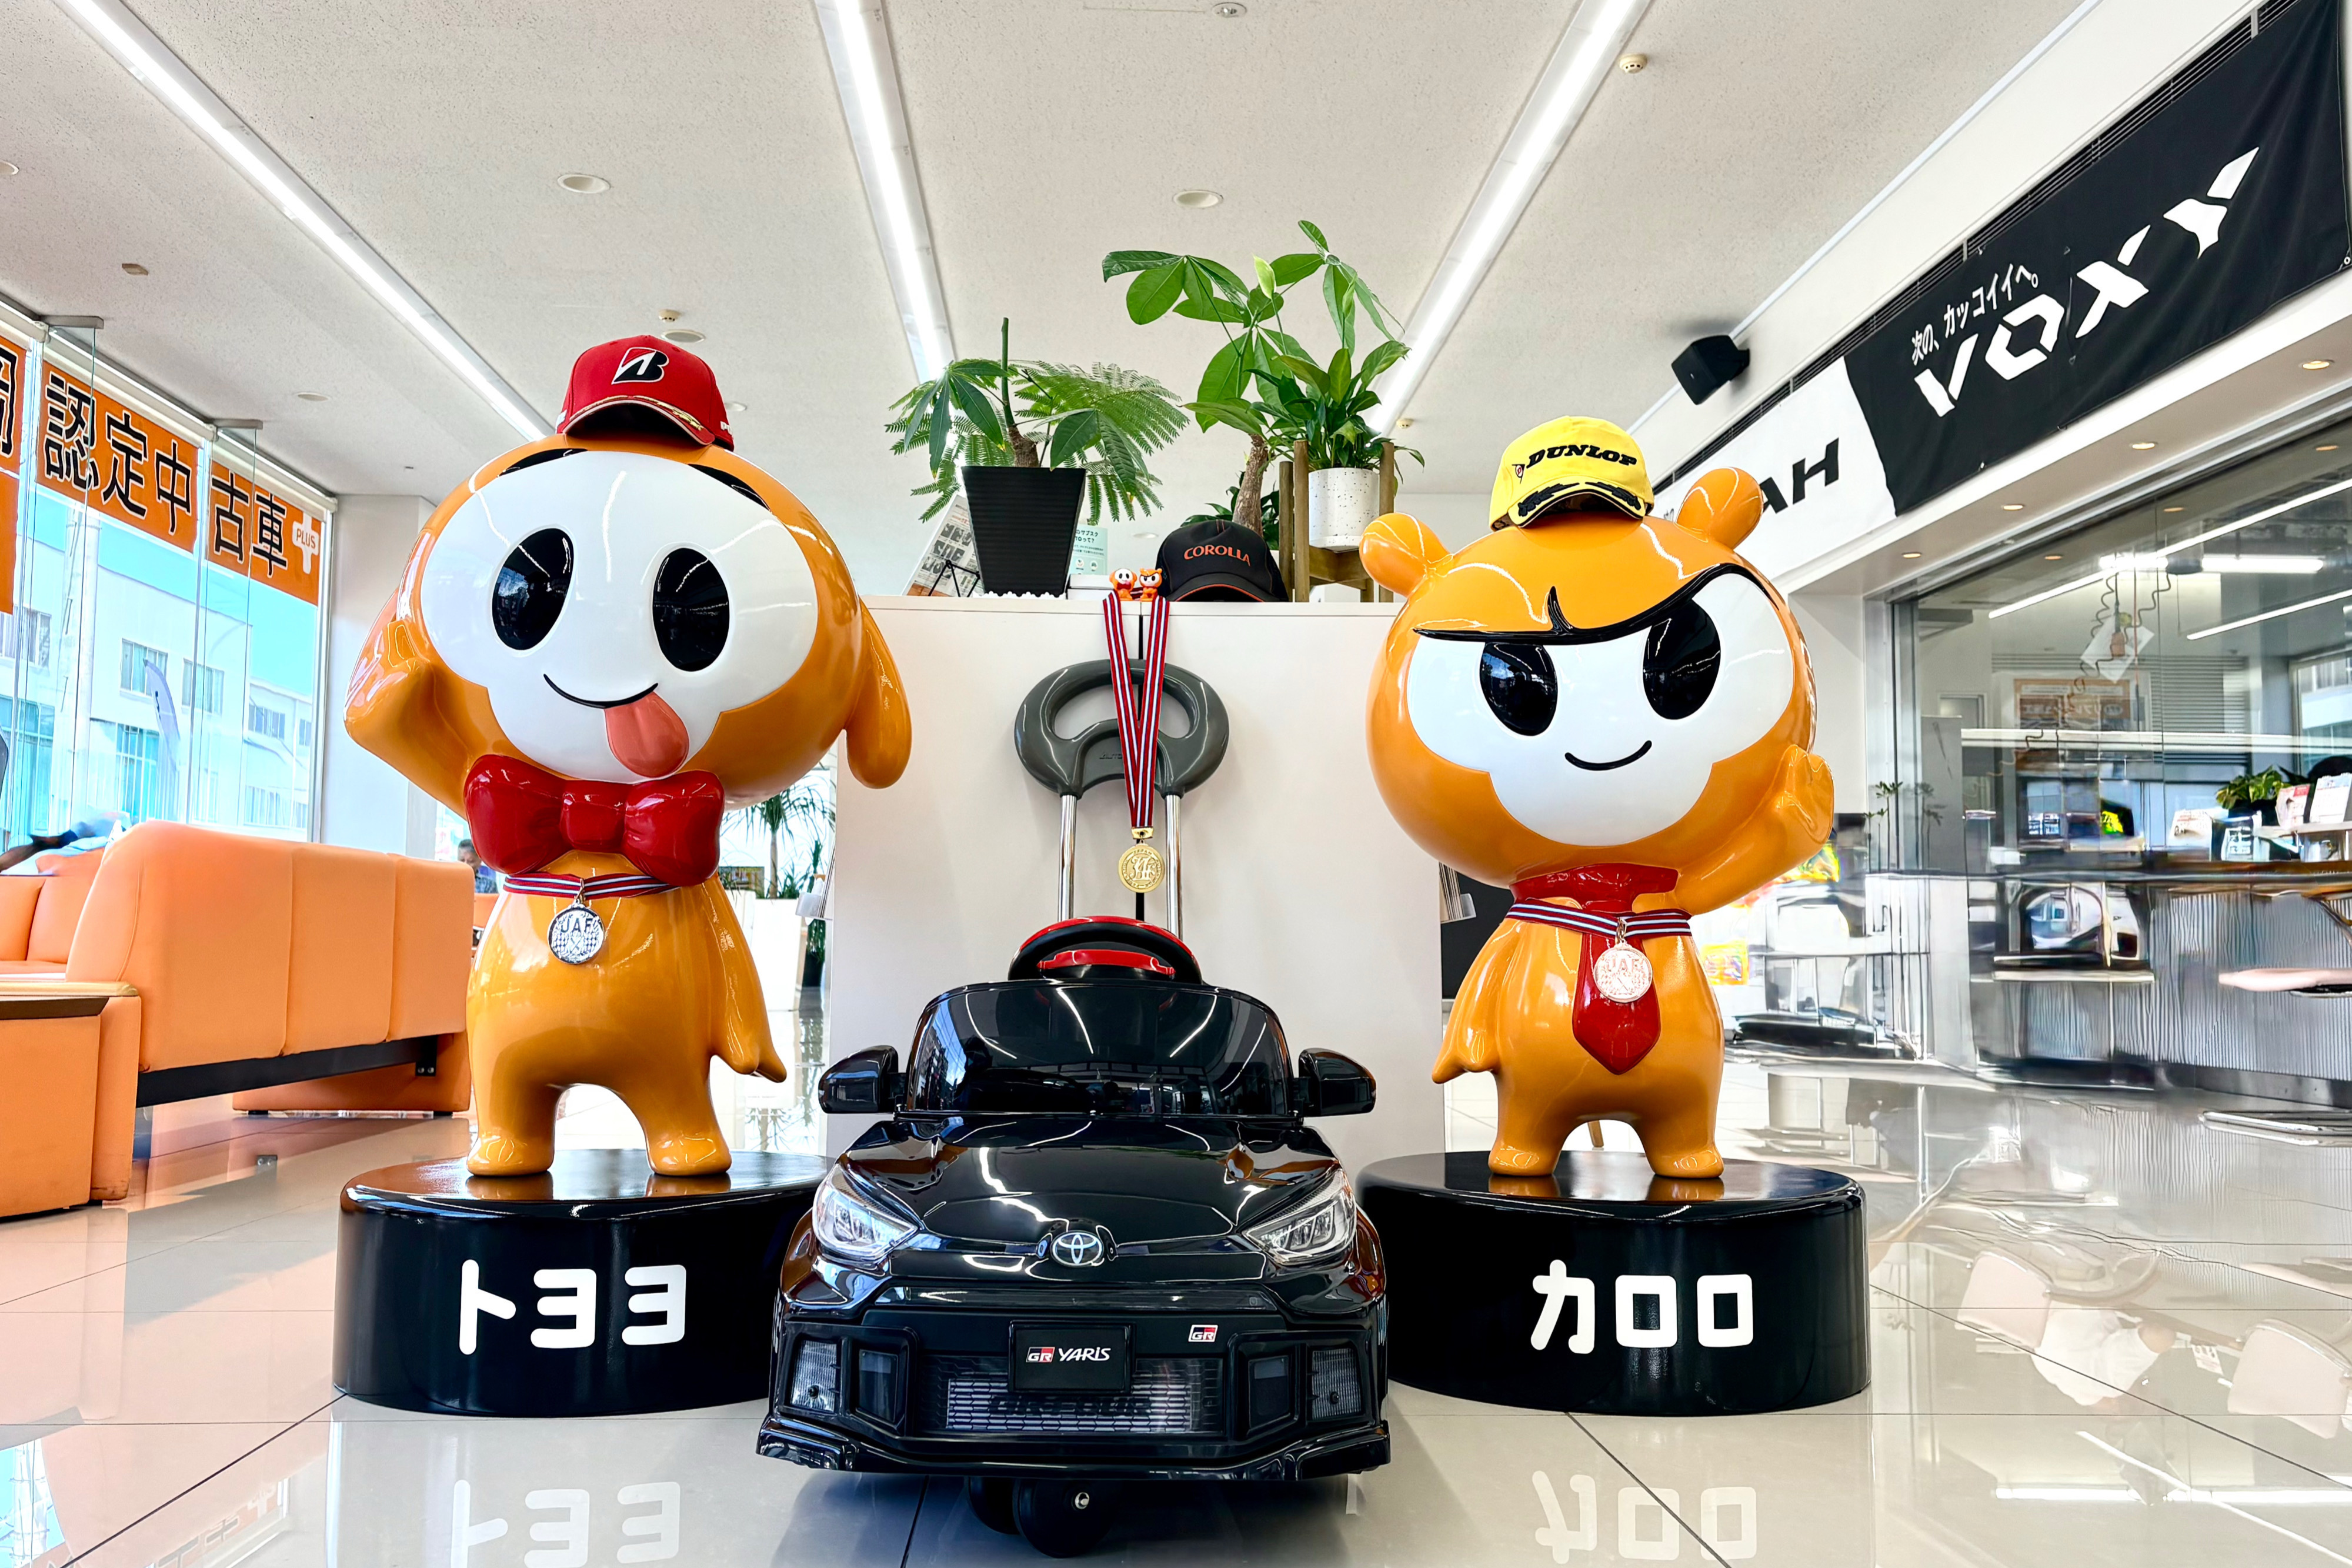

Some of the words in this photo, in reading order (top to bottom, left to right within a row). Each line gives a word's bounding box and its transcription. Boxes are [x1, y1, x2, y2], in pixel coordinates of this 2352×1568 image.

[1914, 146, 2260, 417] VOXY
[1526, 445, 1637, 469] DUNLOP
[296, 528, 316, 549] PLUS
[1183, 545, 1250, 566] COROLLA
[561, 918, 593, 933] JAF
[459, 1259, 686, 1355] トヨヨ
[1531, 1259, 1753, 1354] カロロ
[1189, 1329, 1217, 1342] GR
[1027, 1352, 1053, 1362] GR
